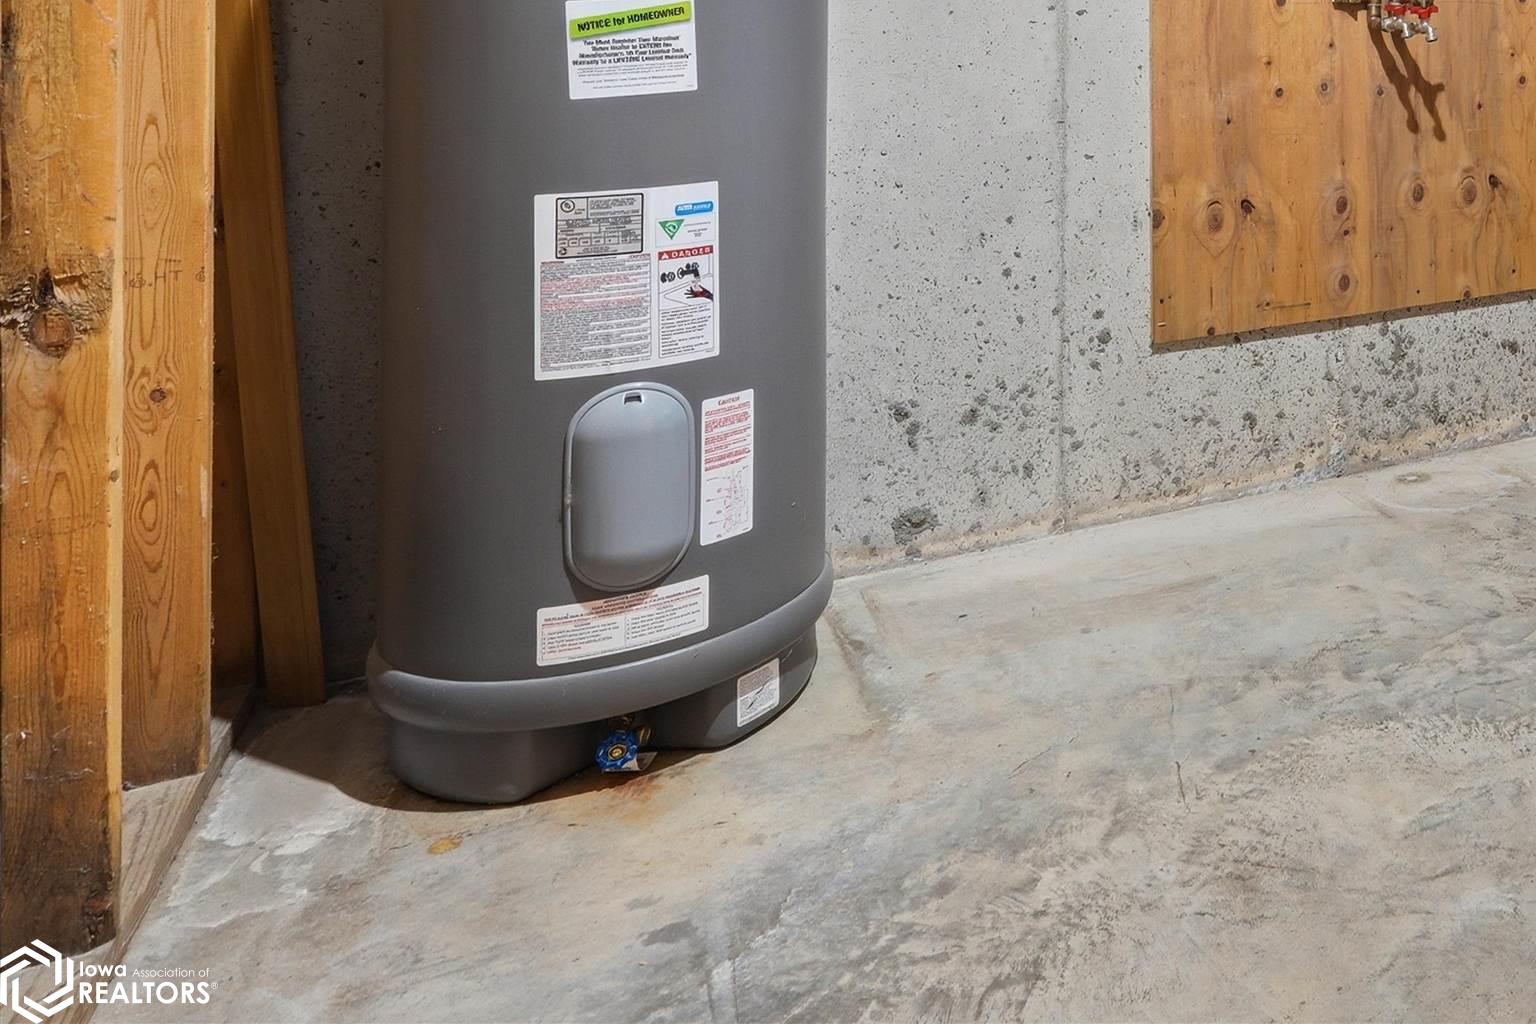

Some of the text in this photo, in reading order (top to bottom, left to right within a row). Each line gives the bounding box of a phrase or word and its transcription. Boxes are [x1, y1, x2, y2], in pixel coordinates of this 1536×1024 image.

[577, 6, 685, 32] NOTICE for HOMEOWNER
